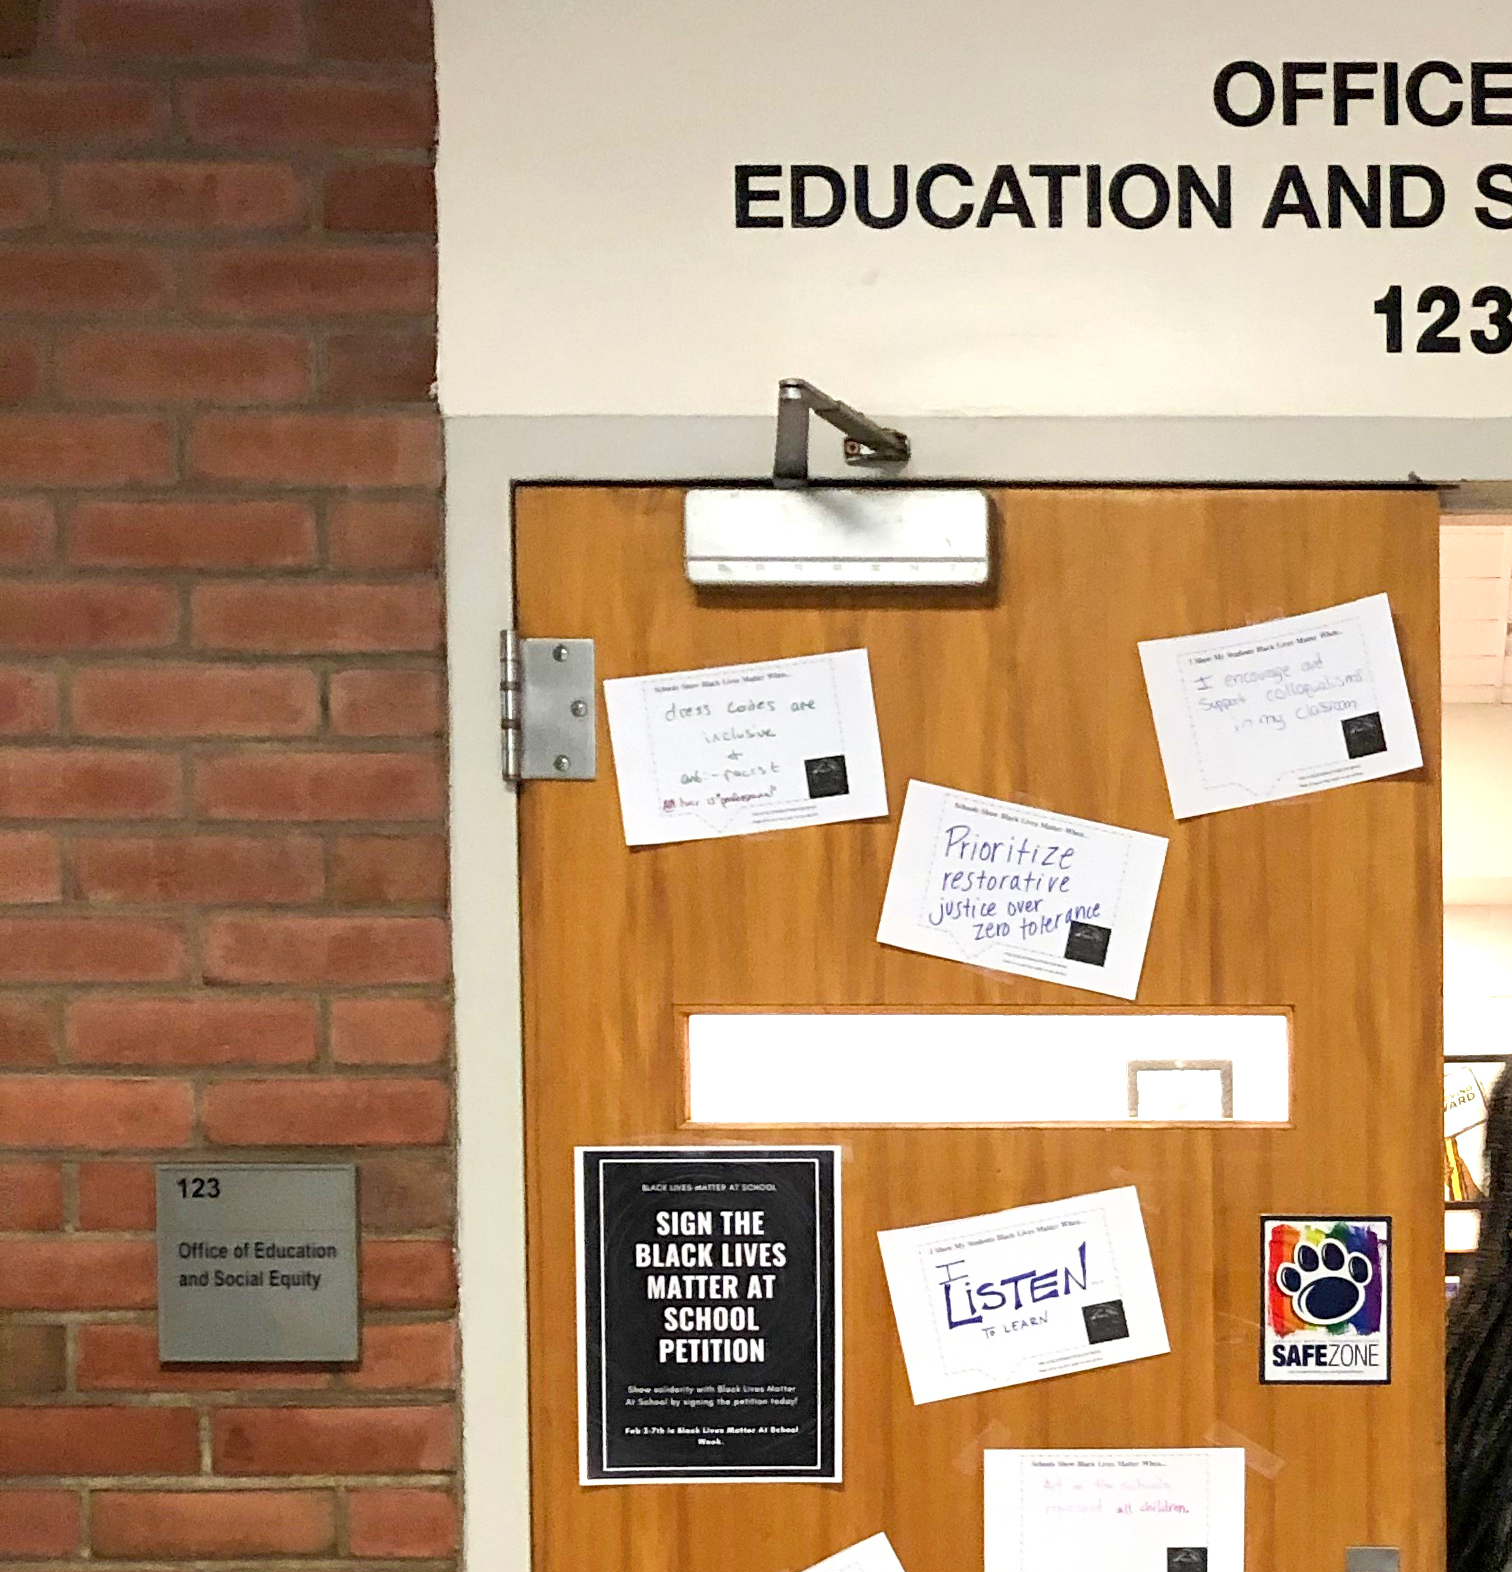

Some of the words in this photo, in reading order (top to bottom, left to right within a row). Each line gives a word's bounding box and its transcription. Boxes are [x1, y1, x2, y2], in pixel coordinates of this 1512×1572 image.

[735, 164, 1231, 229] EDUCATION
[1262, 165, 1445, 228] AND
[1195, 674, 1213, 691] I
[1225, 666, 1290, 687] encourage
[665, 702, 712, 722] dress
[728, 699, 776, 714] codes
[791, 700, 817, 713] are
[1259, 712, 1286, 731] my
[704, 726, 776, 744] inclusive
[945, 824, 1076, 870] Prioritize
[942, 870, 1071, 893] restorative
[928, 896, 996, 926] justice
[1008, 898, 1043, 917] over
[972, 922, 1011, 941] zero
[1020, 901, 1101, 940] tolerance
[176, 1177, 221, 1199] 123
[642, 1184, 667, 1192] BLACK
[669, 1184, 692, 1192] LIVES
[694, 1184, 726, 1192] MATTER
[729, 1184, 740, 1192] AT
[742, 1184, 777, 1192] SCHOOL
[656, 1210, 713, 1236] SIGN
[720, 1210, 765, 1236] THE
[178, 1242, 228, 1260] Office
[233, 1242, 250, 1260] of
[254, 1242, 338, 1260] Education
[635, 1243, 714, 1268] BLACK
[721, 1242, 787, 1268] LIVES
[179, 1270, 210, 1288] and
[214, 1270, 264, 1288] Social
[268, 1270, 322, 1290] Equity
[935, 1260, 969, 1286] I
[647, 1275, 738, 1300] MATTER
[747, 1274, 776, 1299] AT
[664, 1306, 760, 1332] SCHOOL
[1004, 1310, 1049, 1334] LEARN
[659, 1338, 765, 1364] PETITION
[1272, 1344, 1380, 1368] SAFEZONE
[627, 1385, 652, 1394] Show
[696, 1385, 715, 1394] with
[717, 1384, 740, 1394] Black
[743, 1384, 765, 1393] Lives
[766, 1384, 796, 1393] Matter
[638, 1398, 668, 1406] School
[670, 1398, 680, 1408] by
[716, 1397, 731, 1406] the
[733, 1398, 768, 1407] petition
[624, 1426, 641, 1435] Feb
[676, 1426, 700, 1434] Black
[702, 1426, 725, 1434] Lives
[726, 1426, 756, 1434] Matter
[770, 1426, 799, 1434] School
